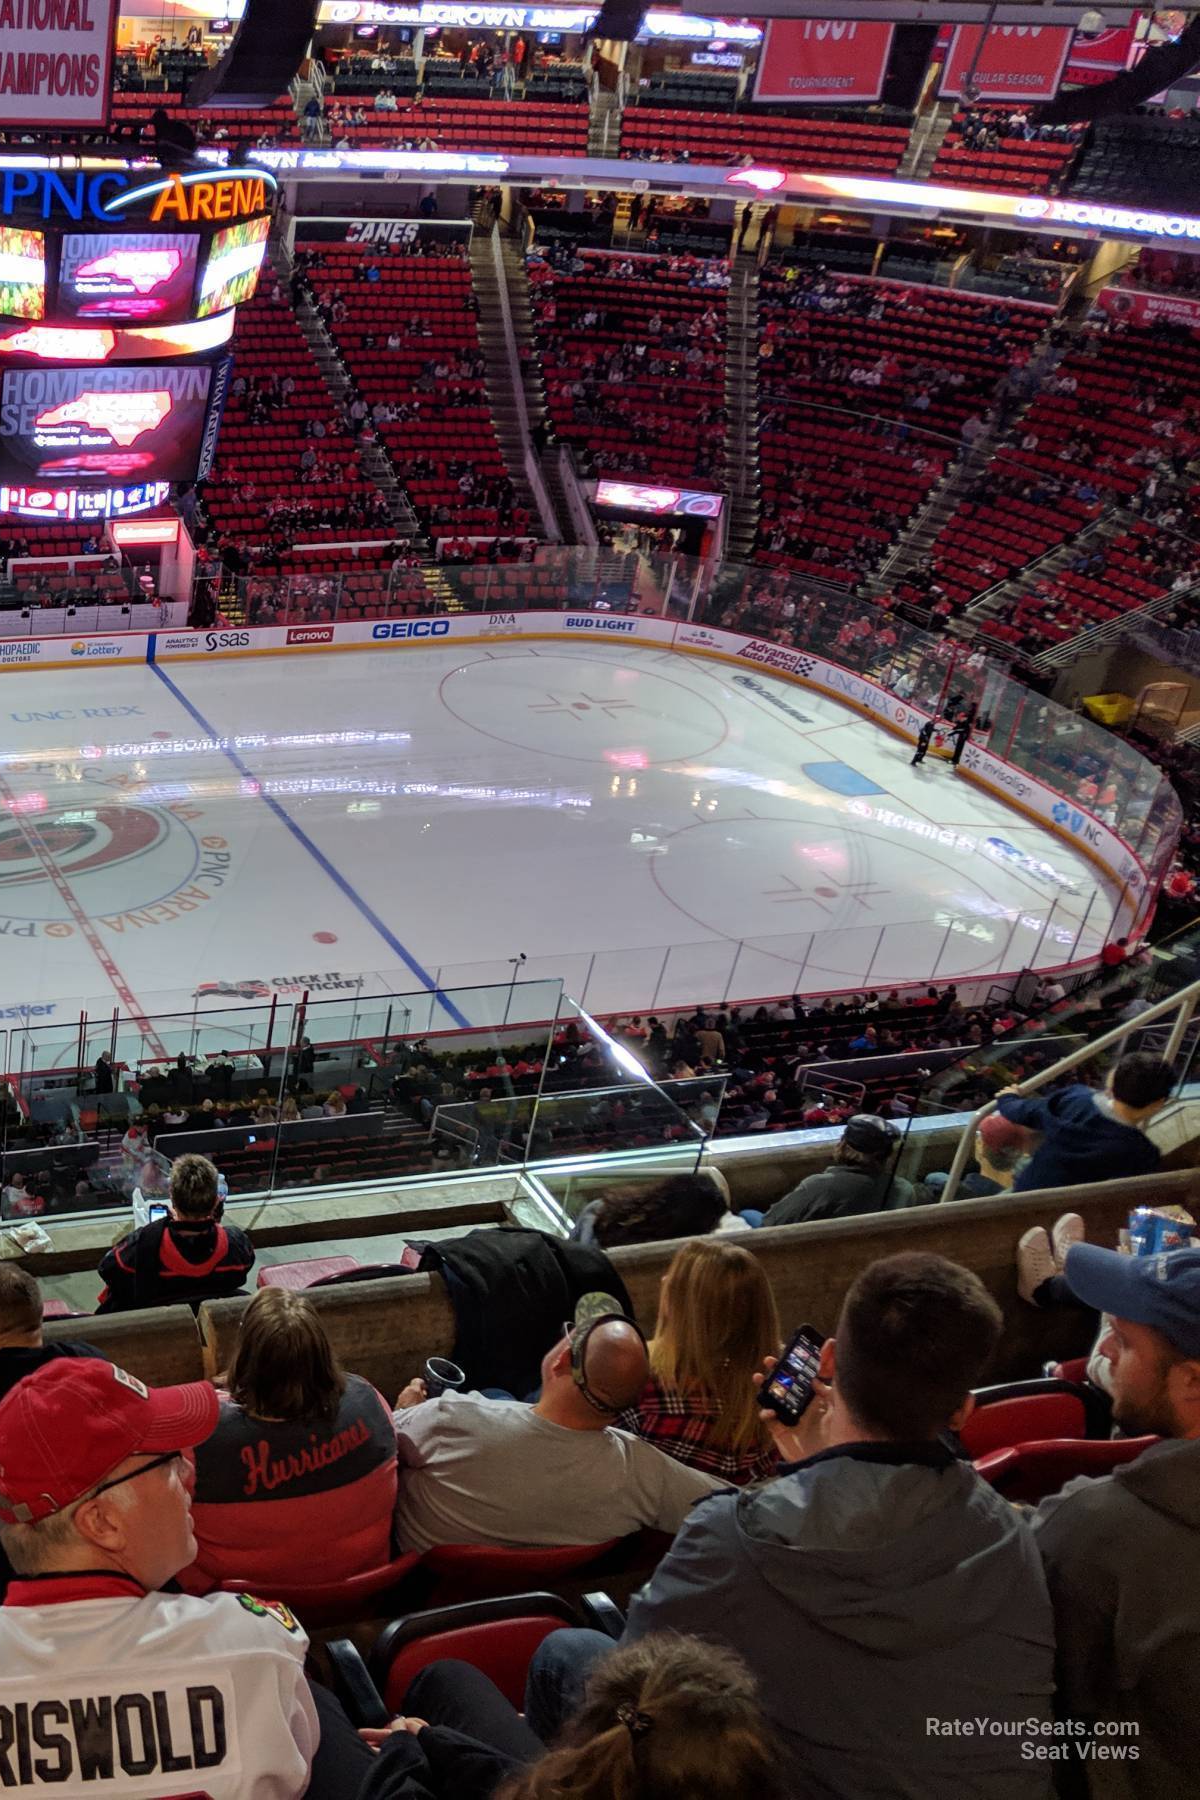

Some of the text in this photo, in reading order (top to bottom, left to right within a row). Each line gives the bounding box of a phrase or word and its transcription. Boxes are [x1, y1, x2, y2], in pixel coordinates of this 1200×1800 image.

[788, 77, 855, 88] TOURNAMENT
[960, 72, 1006, 83] RGULAR
[2, 168, 266, 222] PNC ARENA
[345, 221, 419, 243] CANES
[488, 614, 516, 625] DNA
[565, 617, 636, 632] BUD LIGHT
[290, 629, 330, 641] Lenovo
[372, 620, 450, 639] GEICO
[218, 632, 250, 647] sas
[87, 645, 122, 655] Lottery
[748, 640, 797, 664] Advance
[736, 648, 794, 673] Auto Parts
[824, 668, 894, 715] UNC REX
[11, 705, 145, 723] UNC REX
[982, 759, 1032, 796] invisalign
[1084, 824, 1103, 846] NC
[271, 972, 341, 986] CLICK IT
[279, 977, 364, 994] OR TICKET
[241, 1418, 371, 1494] Hurricanes
